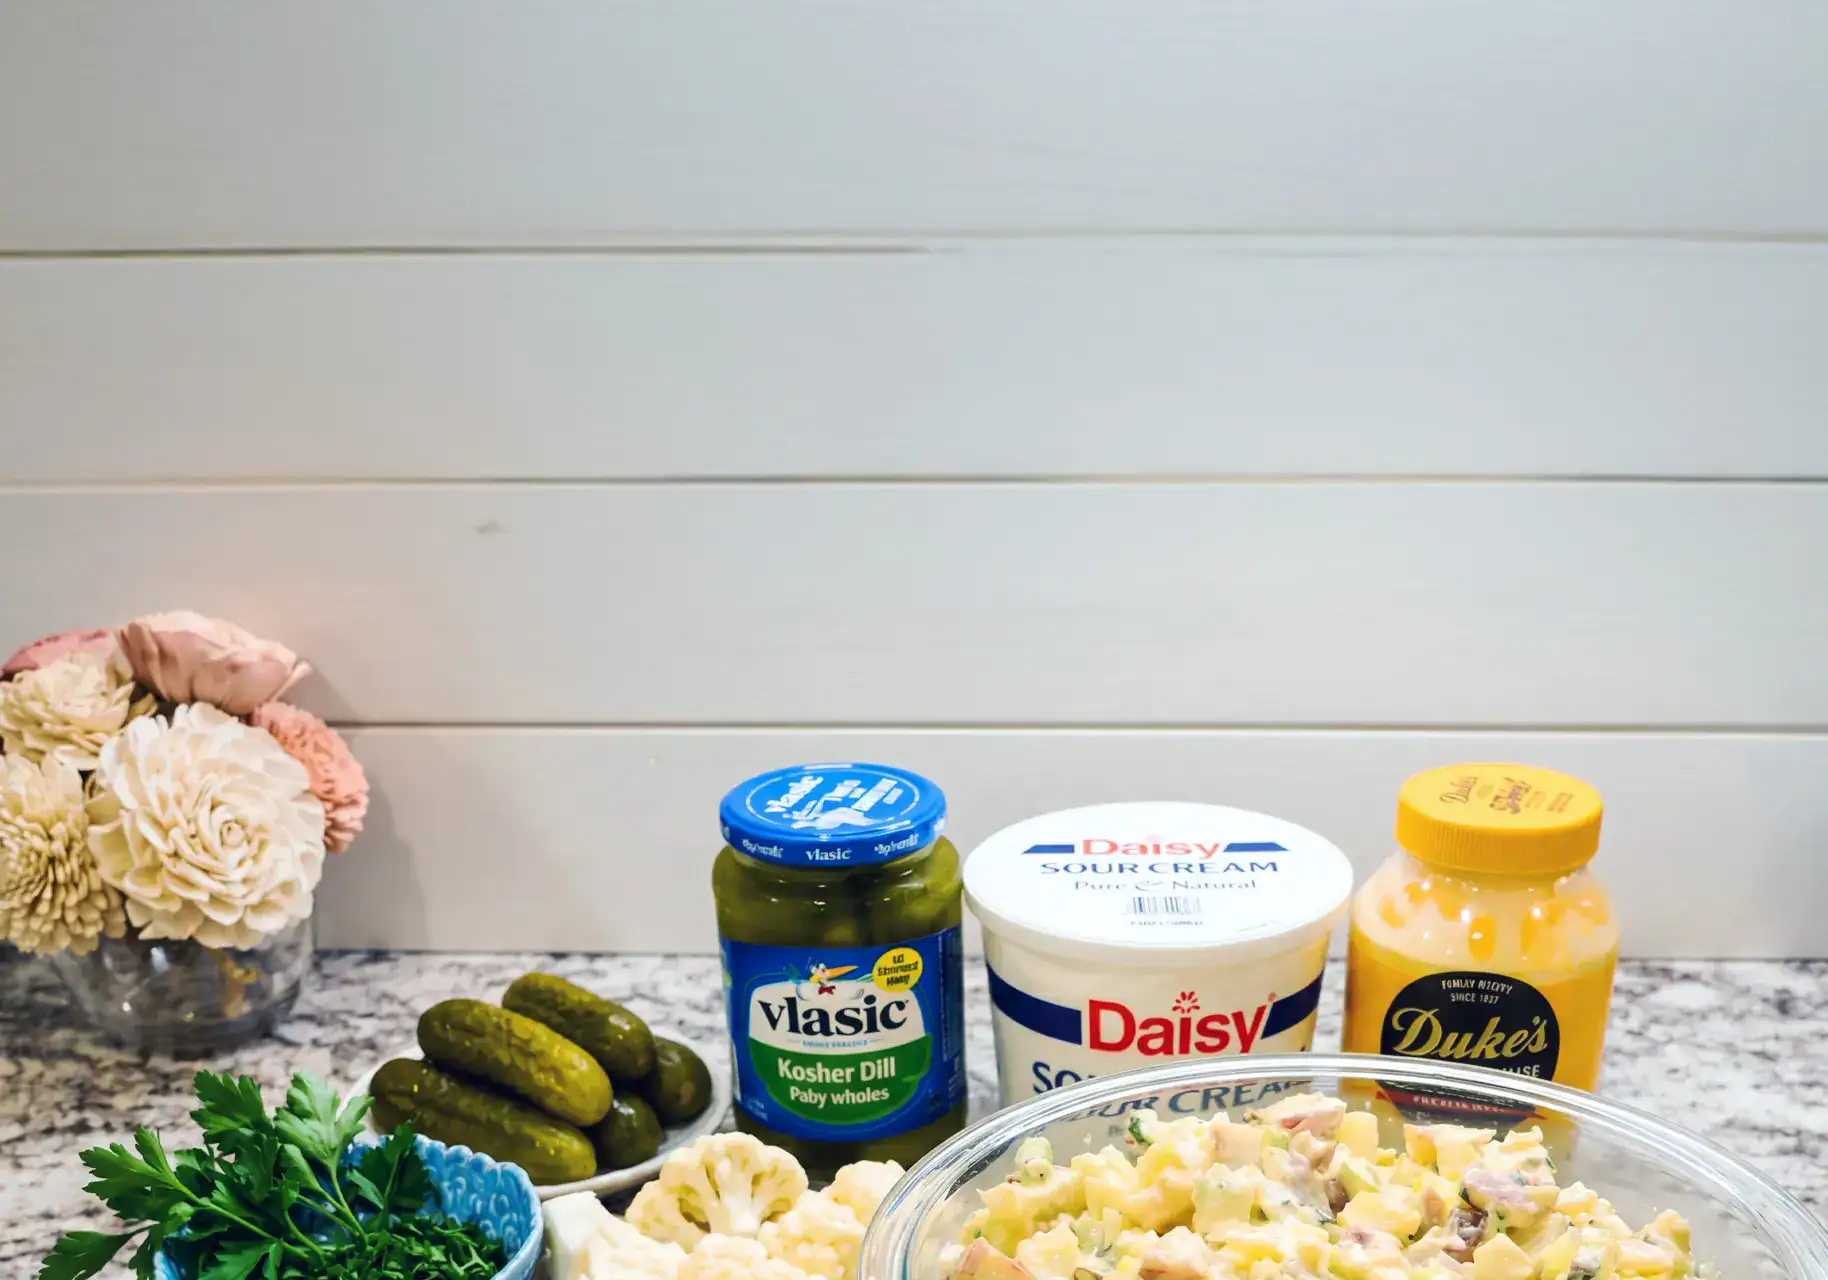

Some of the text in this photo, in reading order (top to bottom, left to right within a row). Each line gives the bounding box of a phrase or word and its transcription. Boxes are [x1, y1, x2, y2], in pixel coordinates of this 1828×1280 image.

[1082, 839, 1221, 860] Daisy
[1041, 861, 1279, 874] SOUR CREAM
[1172, 879, 1256, 891] Natural
[1088, 990, 1274, 1056] Daisy
[1392, 1007, 1548, 1060] Duke's
[777, 1056, 896, 1084] Kosher Dill
[830, 1086, 890, 1105] wholes
